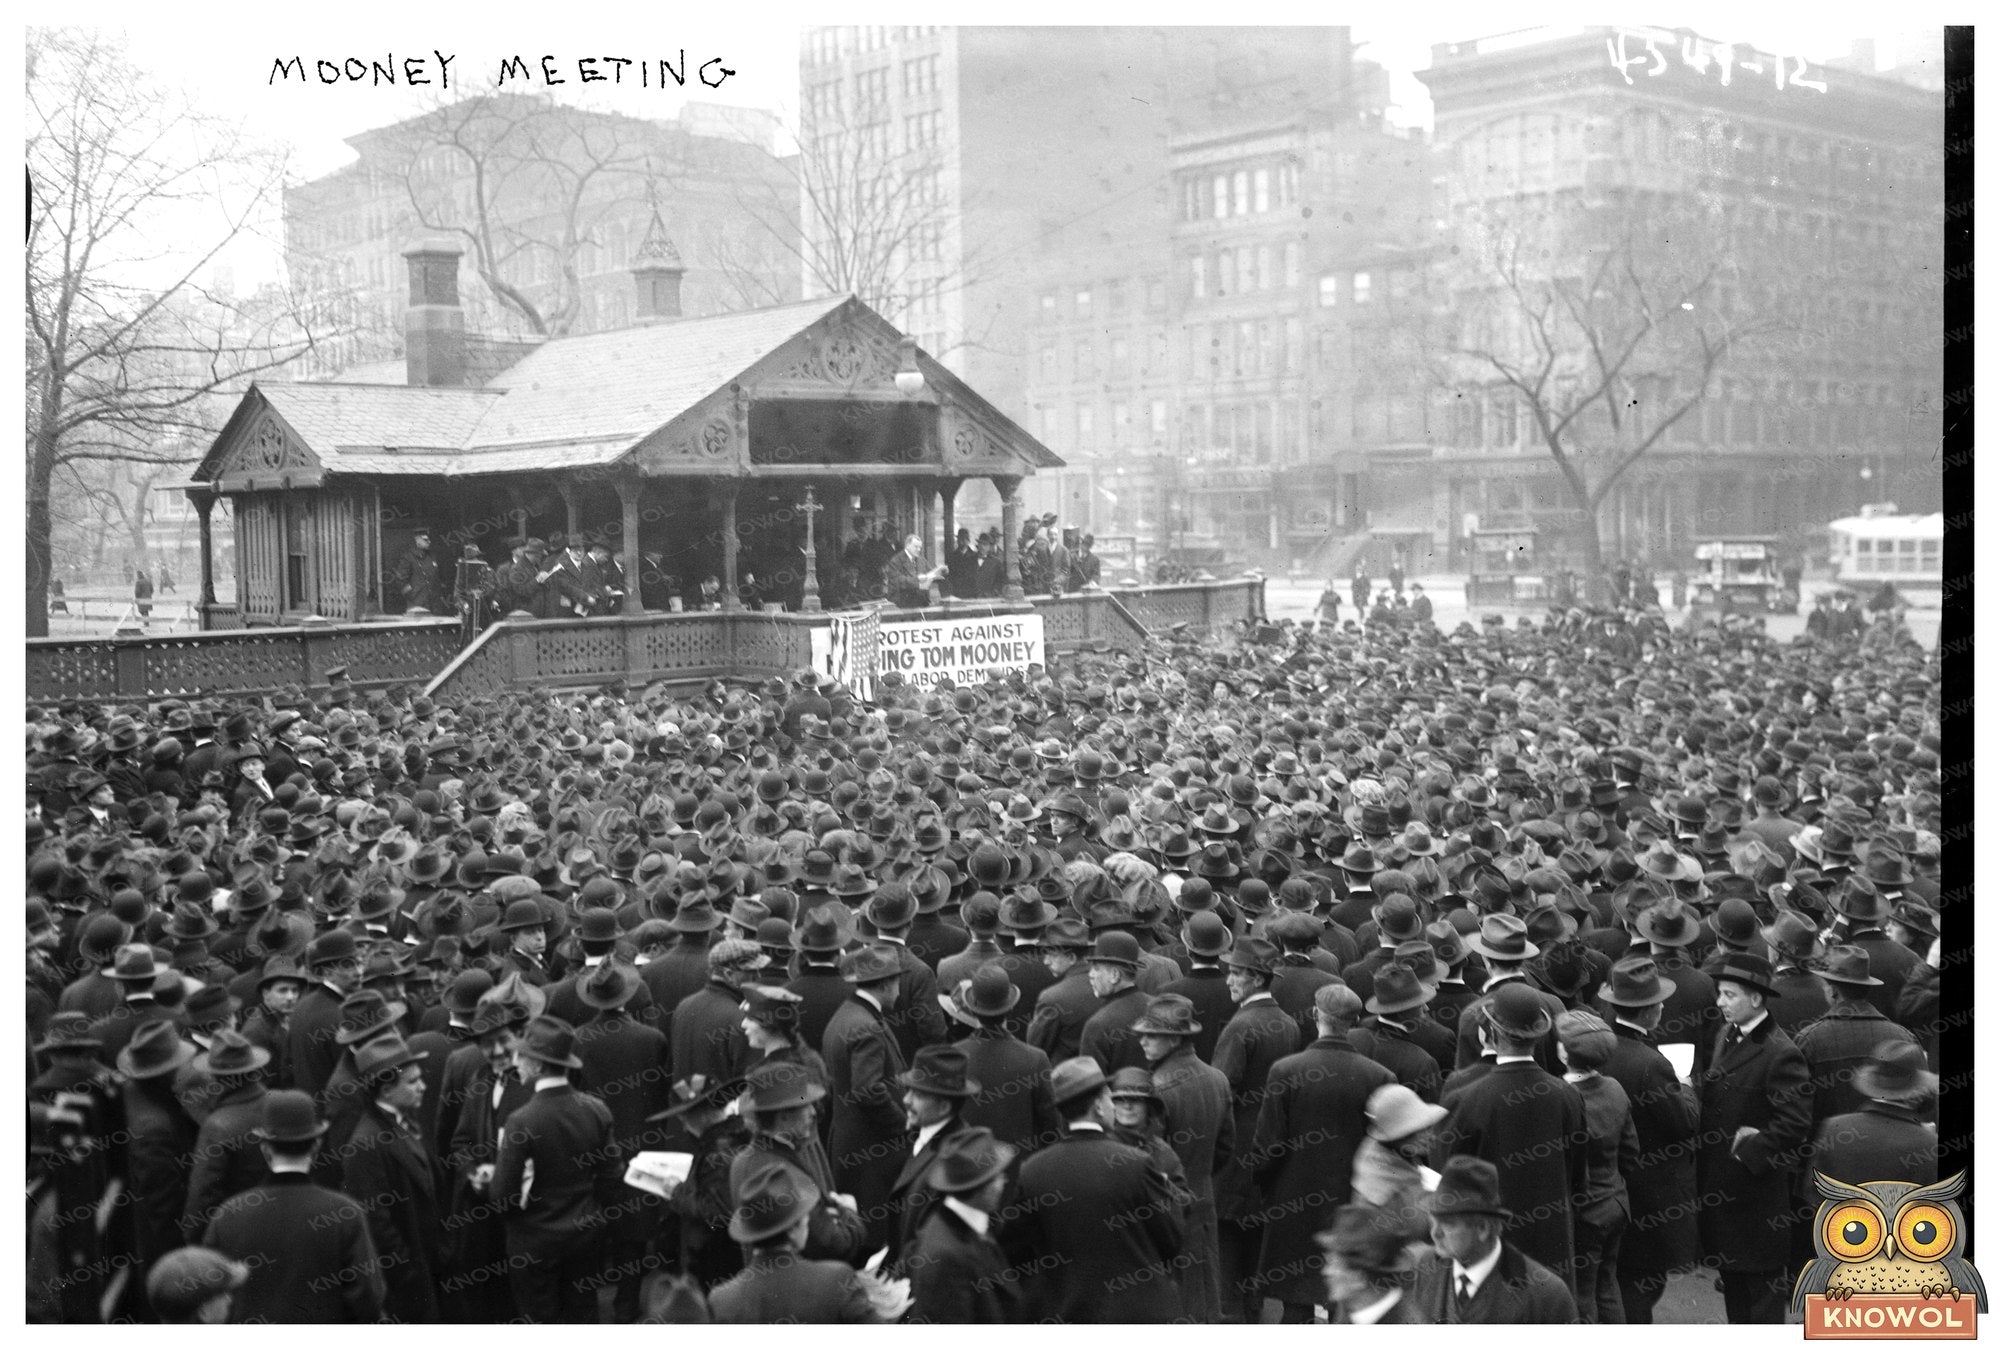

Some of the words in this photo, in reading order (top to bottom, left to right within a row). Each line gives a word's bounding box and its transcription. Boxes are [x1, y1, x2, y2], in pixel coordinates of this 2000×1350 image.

[878, 627, 943, 646] ROTEST
[951, 623, 1024, 642] AGAINST
[920, 646, 955, 669] TOM
[961, 641, 1036, 666] MOONEY
